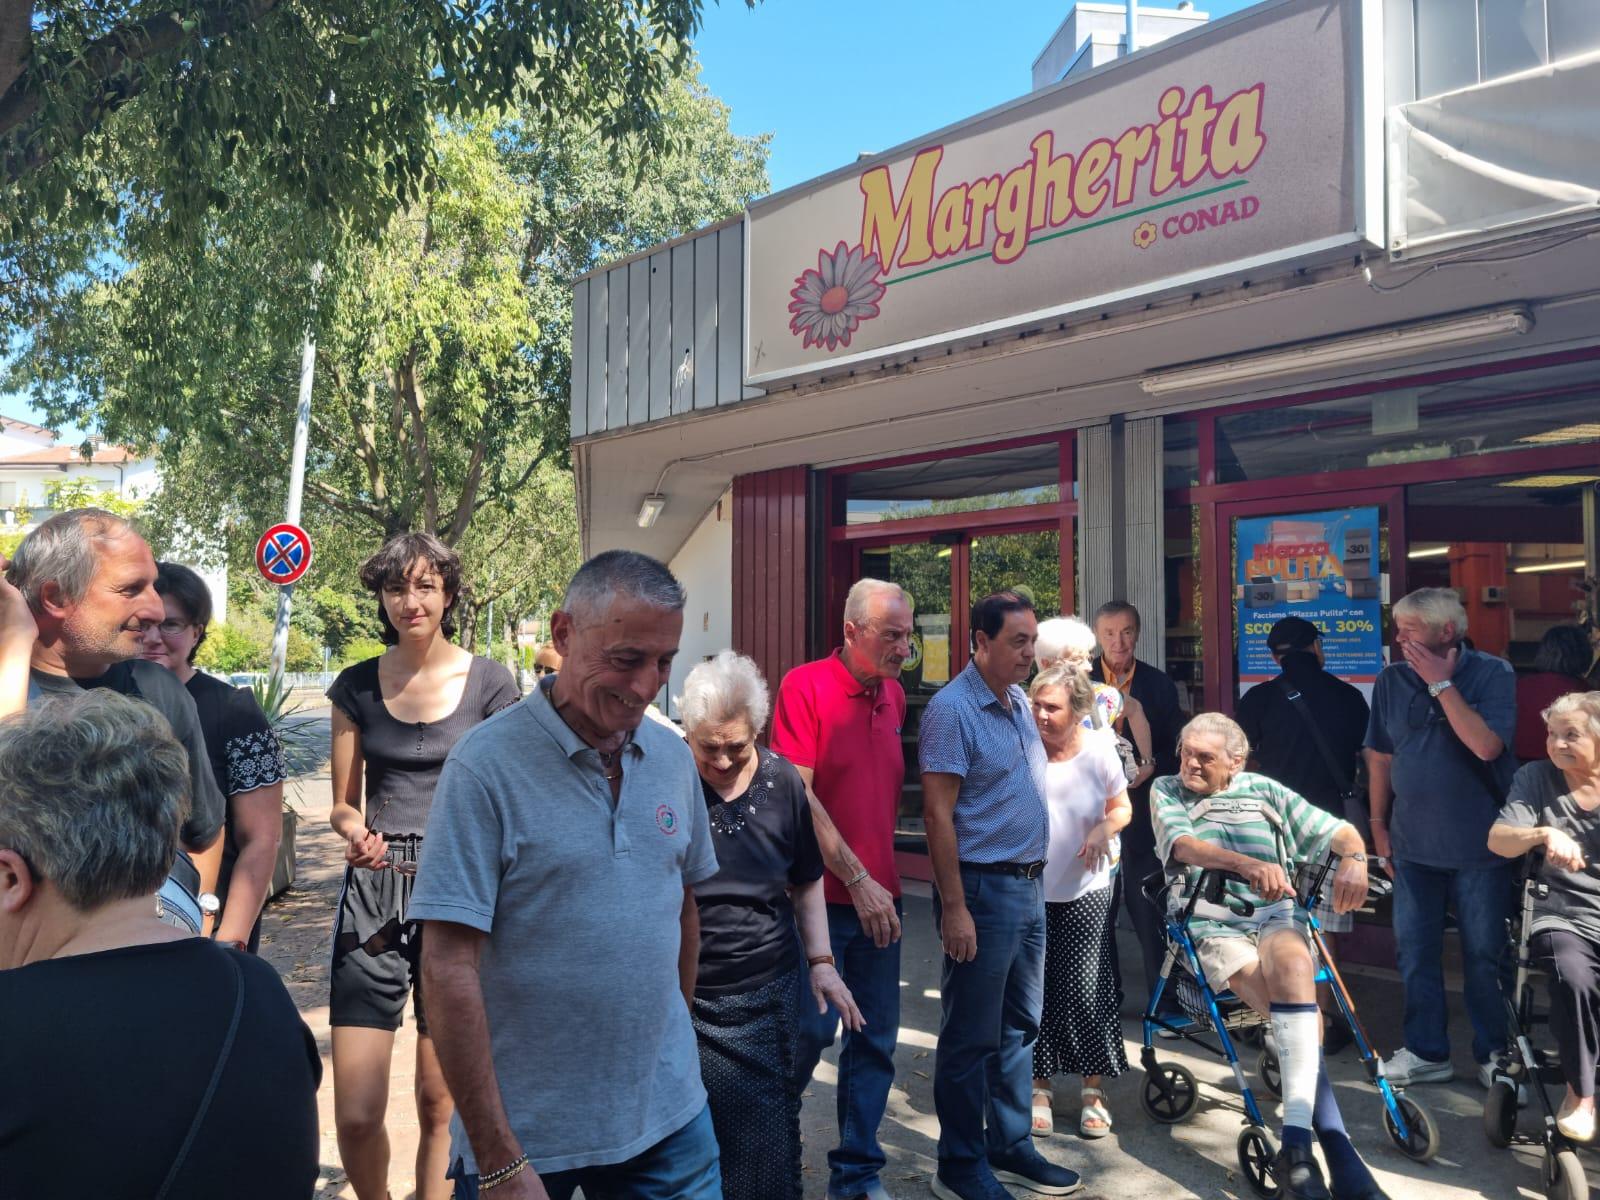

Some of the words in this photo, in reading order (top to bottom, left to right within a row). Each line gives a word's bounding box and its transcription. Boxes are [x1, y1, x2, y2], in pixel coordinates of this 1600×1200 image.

[859, 82, 1266, 276] Margherita
[1162, 195, 1260, 239] CONAD
[1312, 621, 1331, 633] EL
[1335, 619, 1374, 633] 30%
[1349, 609, 1364, 617] con
